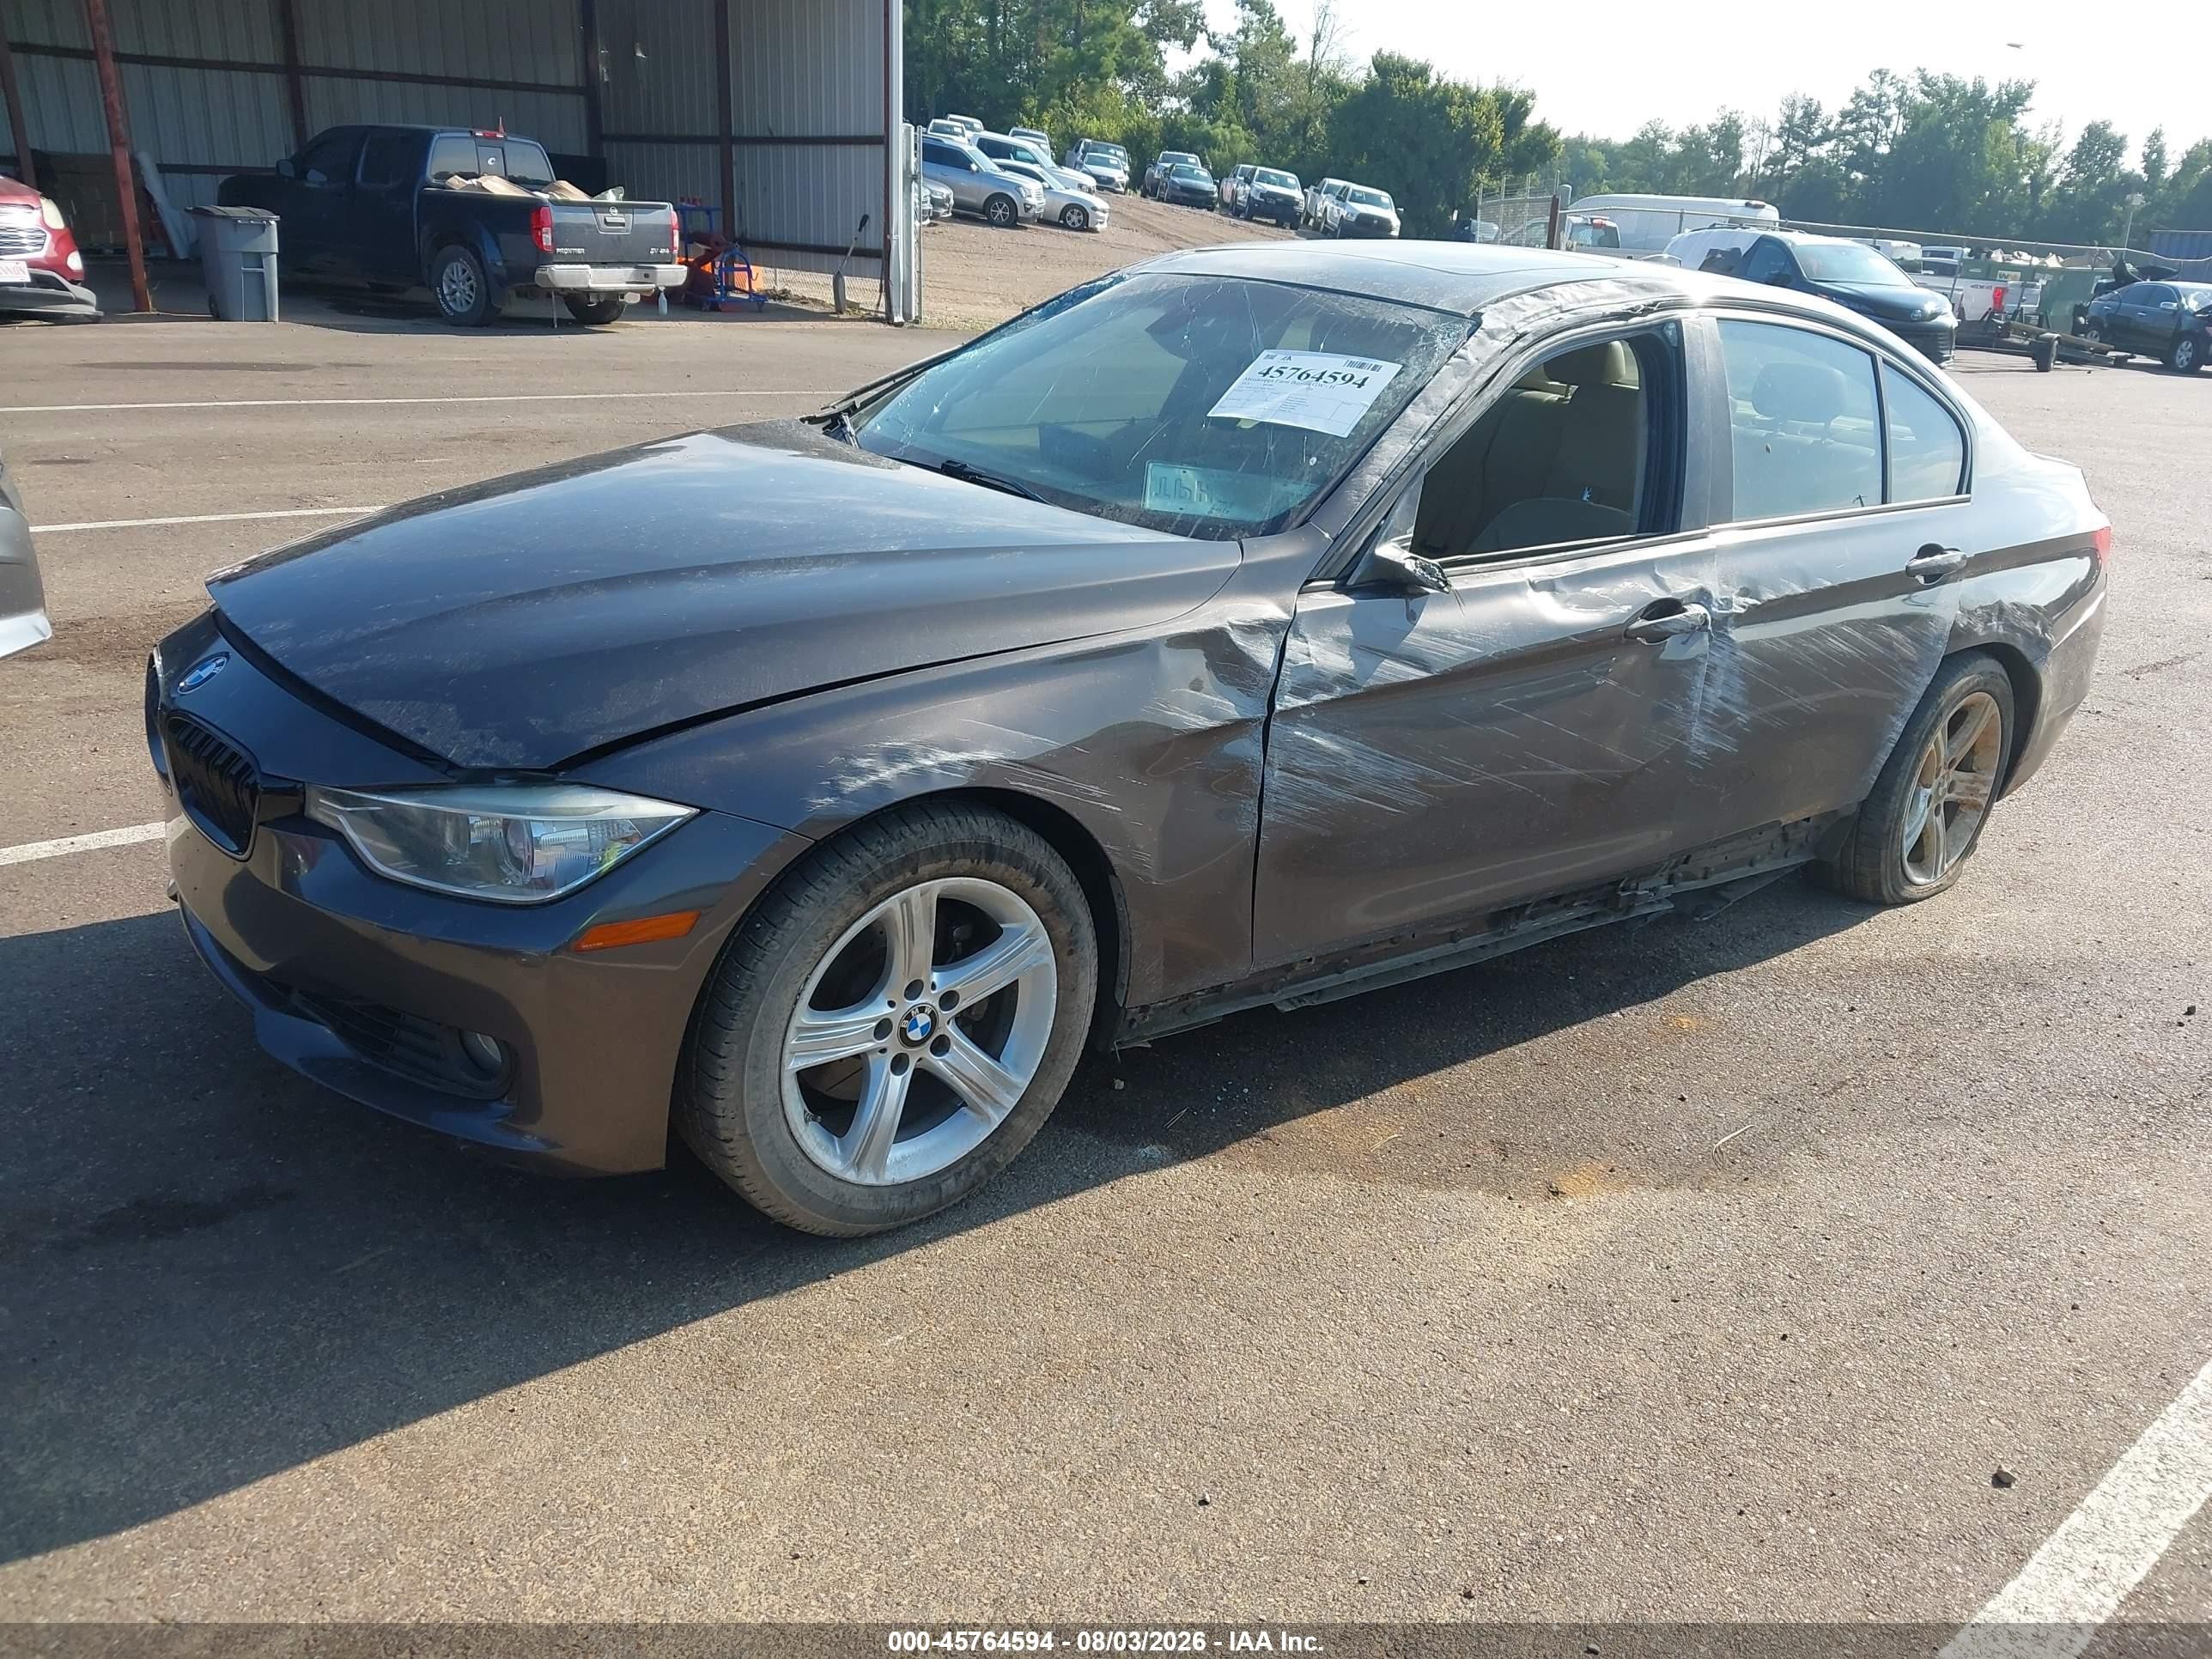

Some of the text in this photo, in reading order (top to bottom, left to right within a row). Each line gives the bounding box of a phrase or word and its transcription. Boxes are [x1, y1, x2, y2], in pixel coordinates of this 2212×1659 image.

[1258, 365, 1370, 389] 45764594
[179, 658, 225, 687] MW
[901, 1006, 932, 1028] BMW
